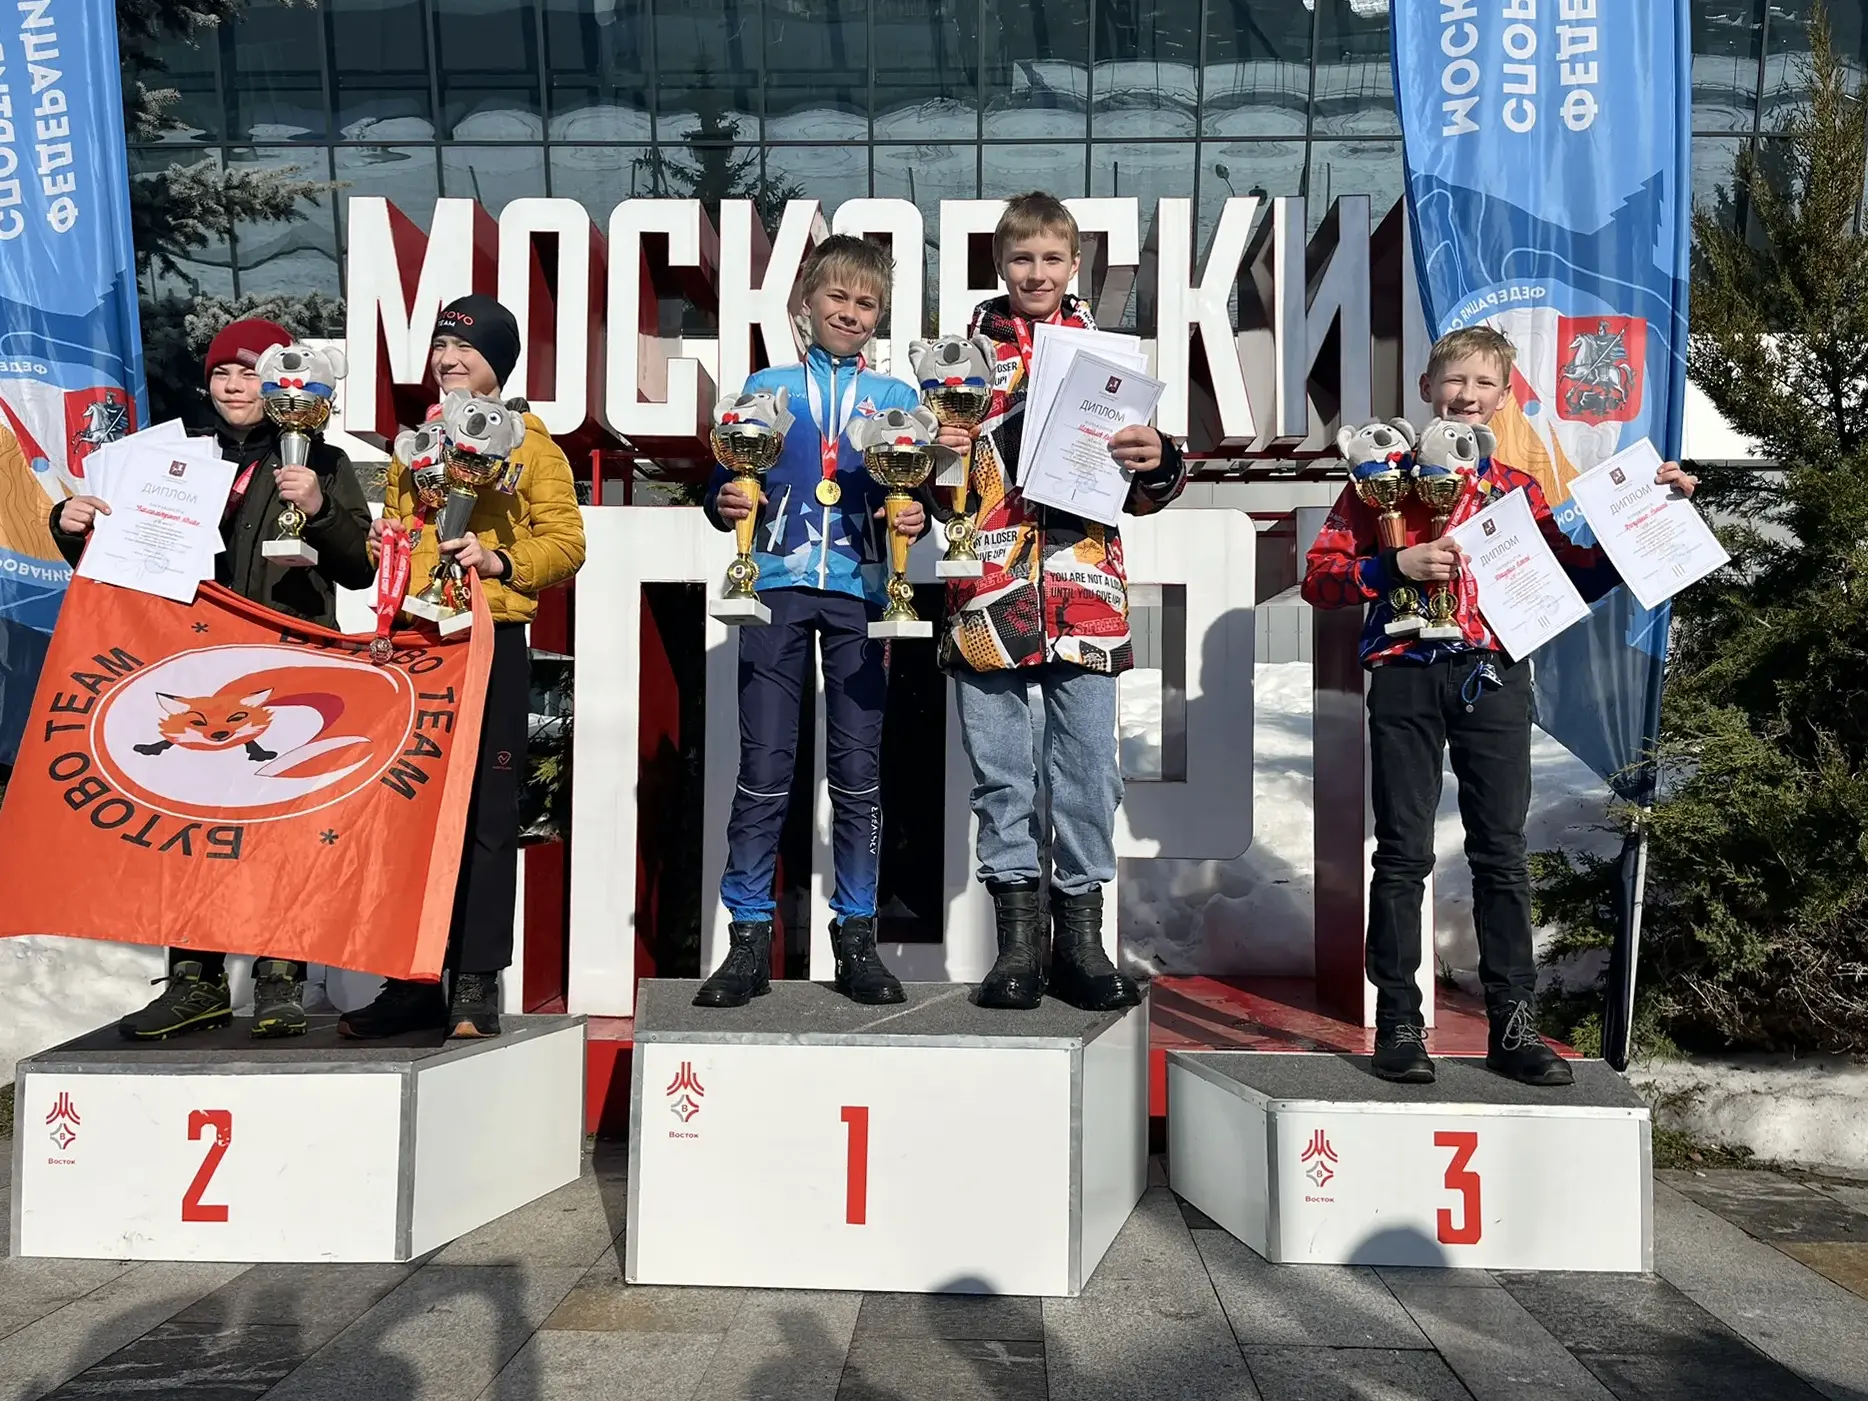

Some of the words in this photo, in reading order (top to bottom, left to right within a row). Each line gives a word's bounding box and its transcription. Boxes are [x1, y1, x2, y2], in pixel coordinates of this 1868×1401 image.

[1079, 399, 1126, 423] ДИПЛОМ
[141, 482, 199, 504] ДИПЛОМ
[1610, 484, 1653, 516] ДИПЛОМ
[991, 531, 1018, 545] LOSER
[1479, 534, 1520, 567] ДИПЛОМ
[1050, 572, 1067, 582] YOU
[1069, 572, 1086, 583] ARE
[1087, 573, 1103, 585] NOT
[1104, 576, 1110, 587] A
[1051, 586, 1075, 599] UNTIL
[1078, 587, 1095, 599] YOU
[1096, 589, 1112, 603] GIVE
[44, 646, 146, 743] TEAM
[380, 685, 456, 801] TEAM
[48, 751, 244, 861] БУТОВО
[668, 1131, 699, 1139] Восток
[48, 1157, 76, 1165] Восток
[181, 1109, 232, 1222] 2
[840, 1105, 869, 1225] 1
[1305, 1195, 1335, 1203] Восток
[1433, 1131, 1482, 1245] 3
